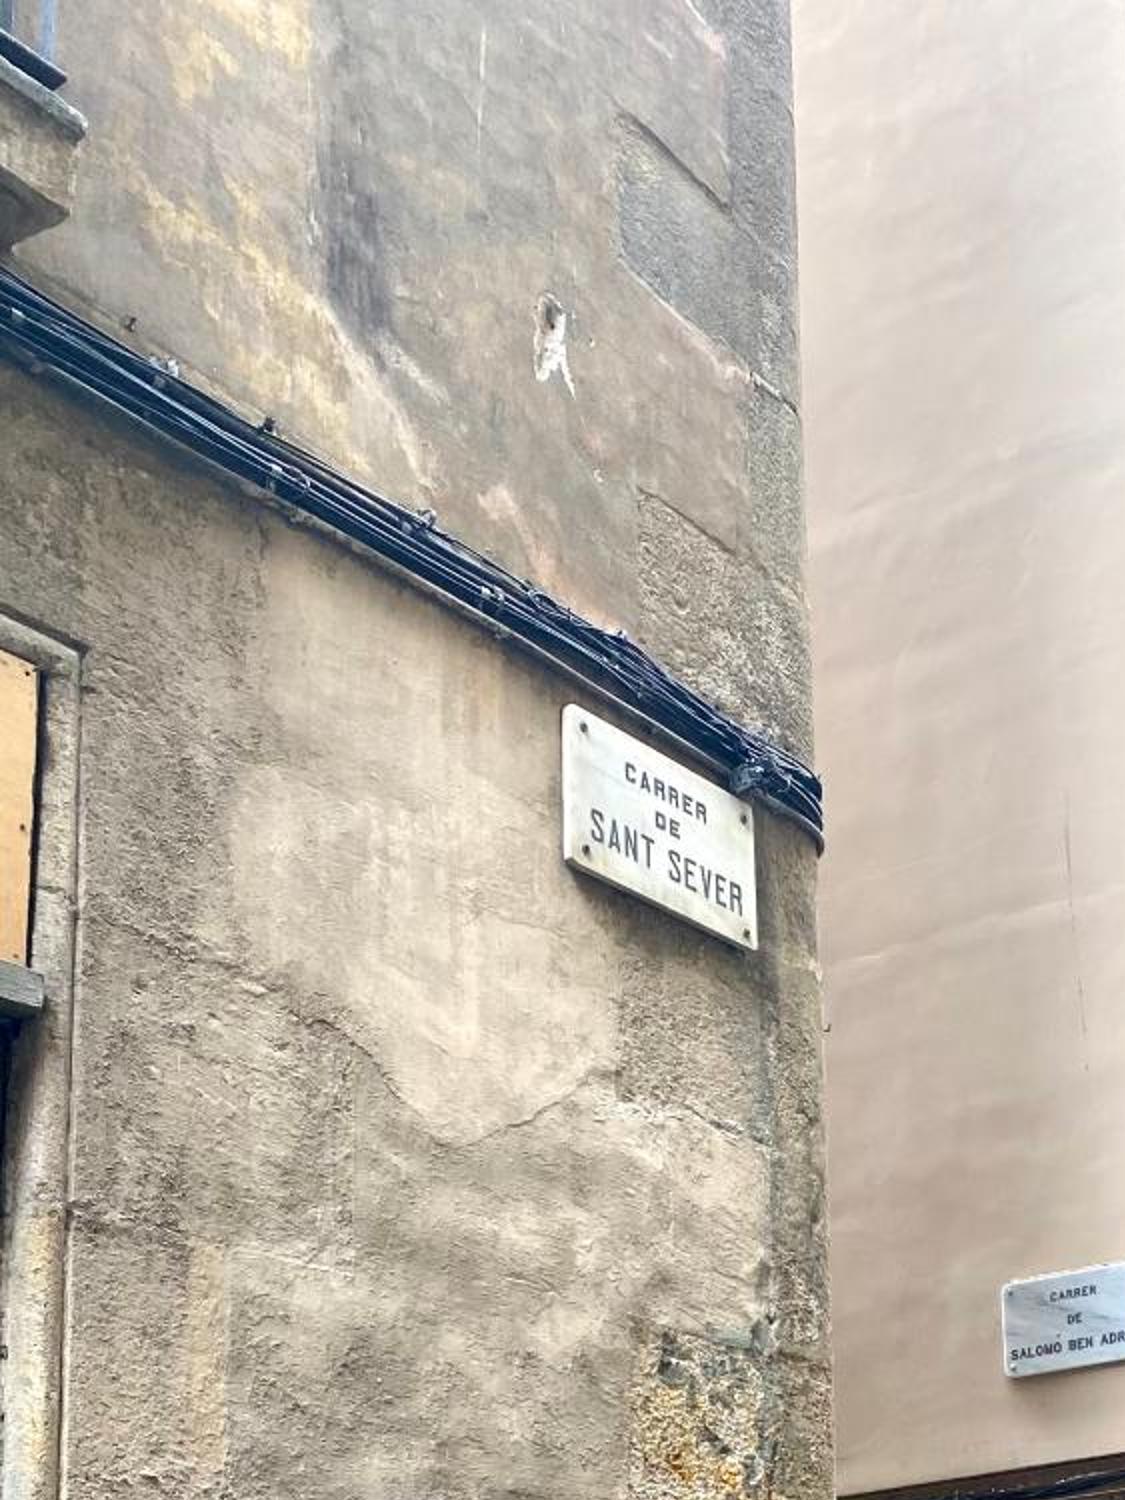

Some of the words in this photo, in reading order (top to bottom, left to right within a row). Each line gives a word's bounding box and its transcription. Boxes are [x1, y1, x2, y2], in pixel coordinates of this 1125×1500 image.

[625, 762, 707, 825] CARRER
[655, 811, 681, 840] DE
[591, 808, 655, 869] SANT
[667, 849, 743, 917] SEVER
[1049, 1284, 1097, 1303] CARRER
[1067, 1312, 1083, 1325] DE
[1067, 1336, 1093, 1351] BEN
